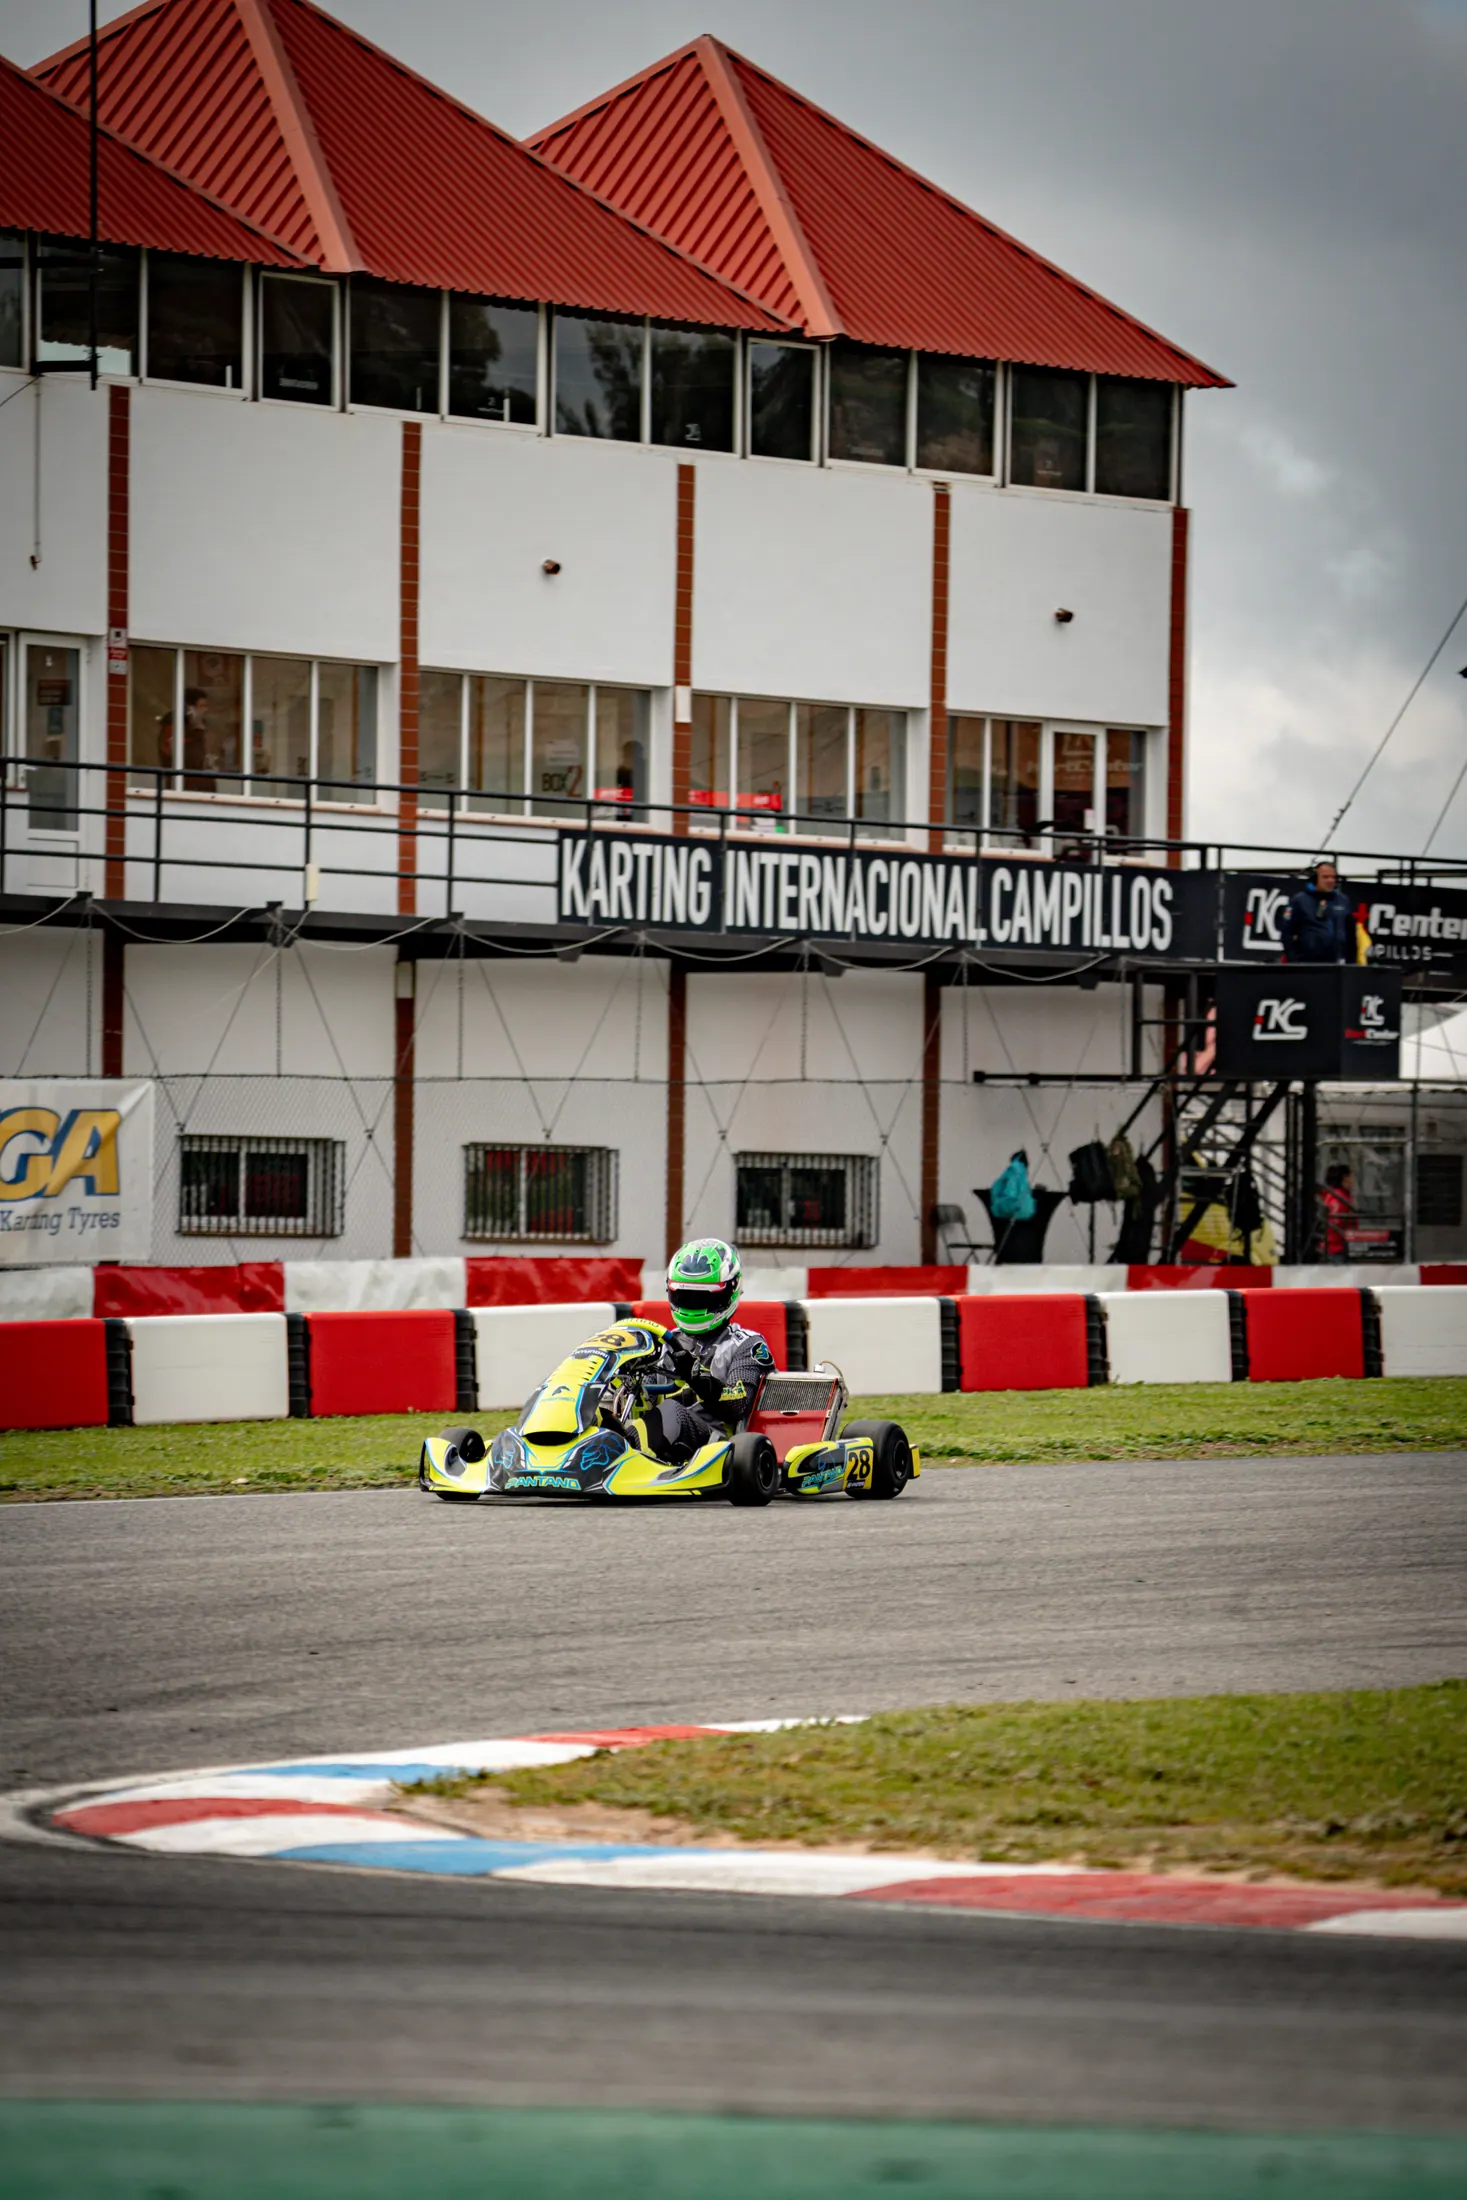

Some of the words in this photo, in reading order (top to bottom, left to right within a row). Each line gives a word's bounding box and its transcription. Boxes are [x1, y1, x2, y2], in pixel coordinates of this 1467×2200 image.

[567, 765, 583, 797] 2
[562, 838, 712, 926] KARTING
[726, 850, 988, 942] INTERNACIONAL
[991, 867, 1173, 951] CAMPILLOS
[1352, 903, 1467, 940] tCenter
[1366, 944, 1432, 960] PILLOS
[68, 1206, 120, 1236] Tyres
[847, 1450, 871, 1480] 28
[504, 1475, 582, 1490] PANTANO
